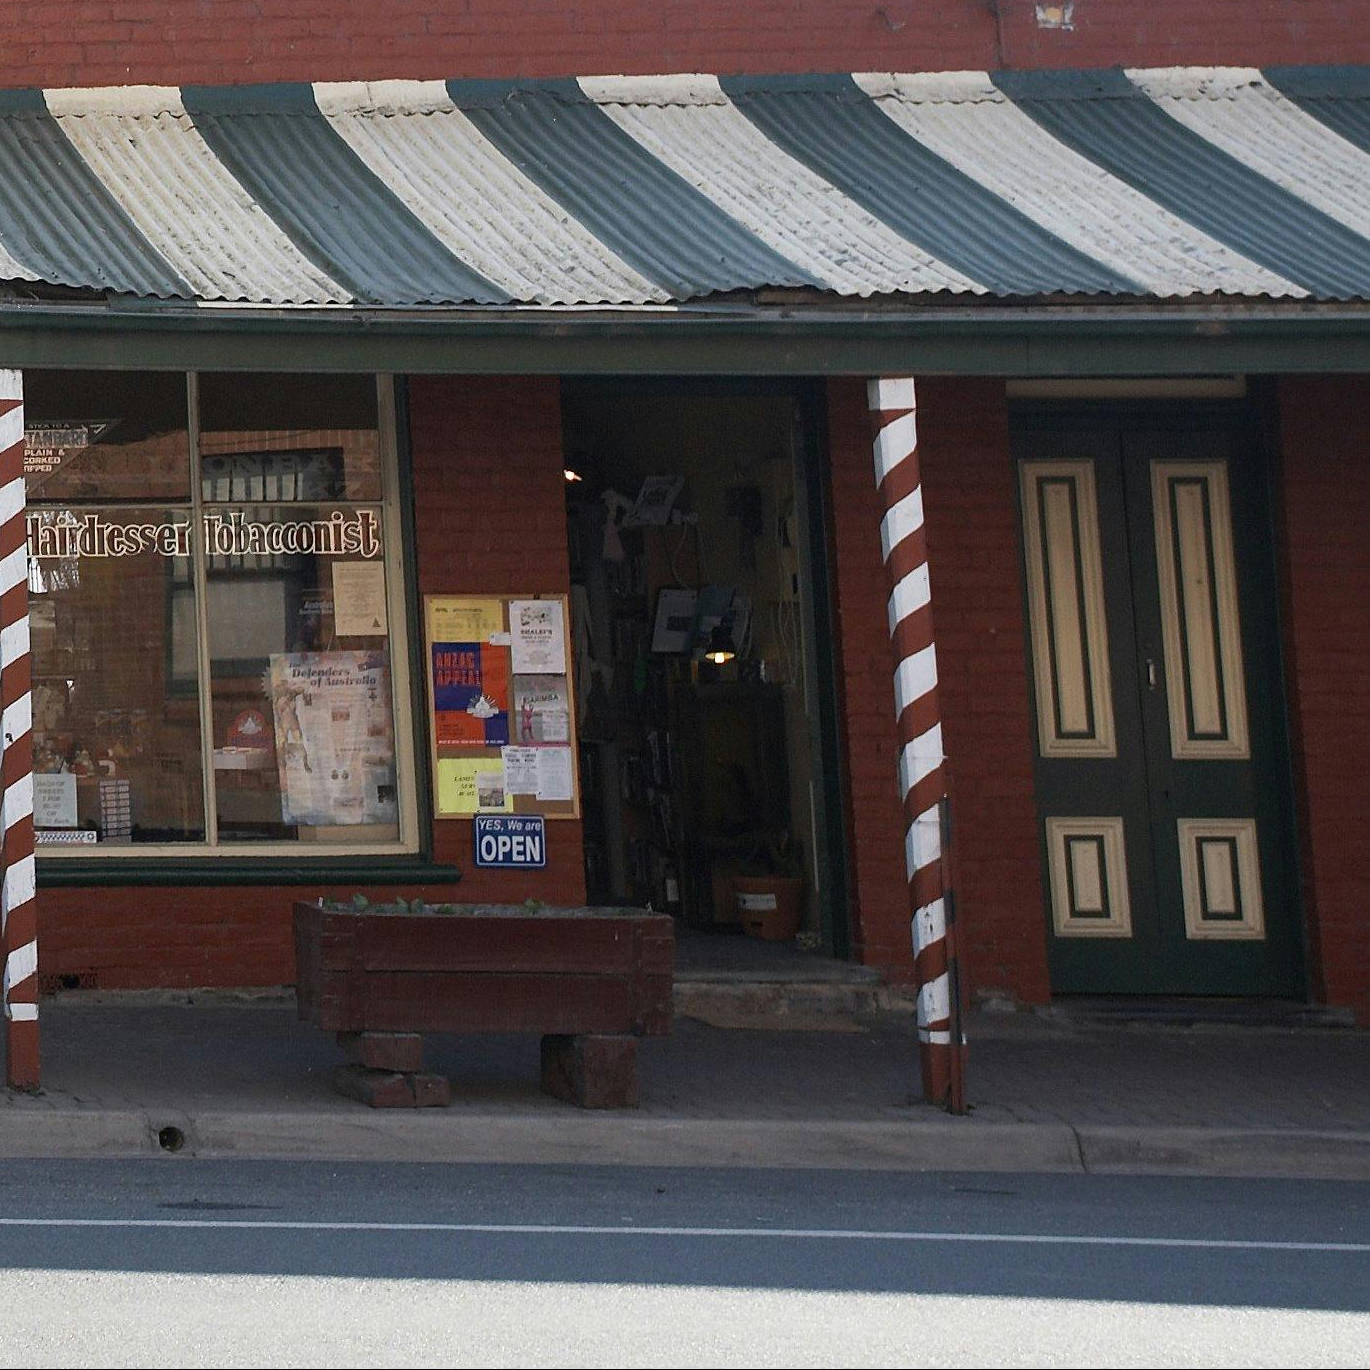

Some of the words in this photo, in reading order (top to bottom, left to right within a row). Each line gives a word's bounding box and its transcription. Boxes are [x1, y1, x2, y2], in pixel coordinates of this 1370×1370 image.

[204, 510, 380, 559] Tobacconist
[436, 651, 476, 669] ANZAC
[436, 670, 482, 687] APPEAL
[480, 819, 504, 830] YES,
[507, 820, 522, 830] We
[525, 822, 541, 830] are
[481, 834, 540, 862] OPEN
